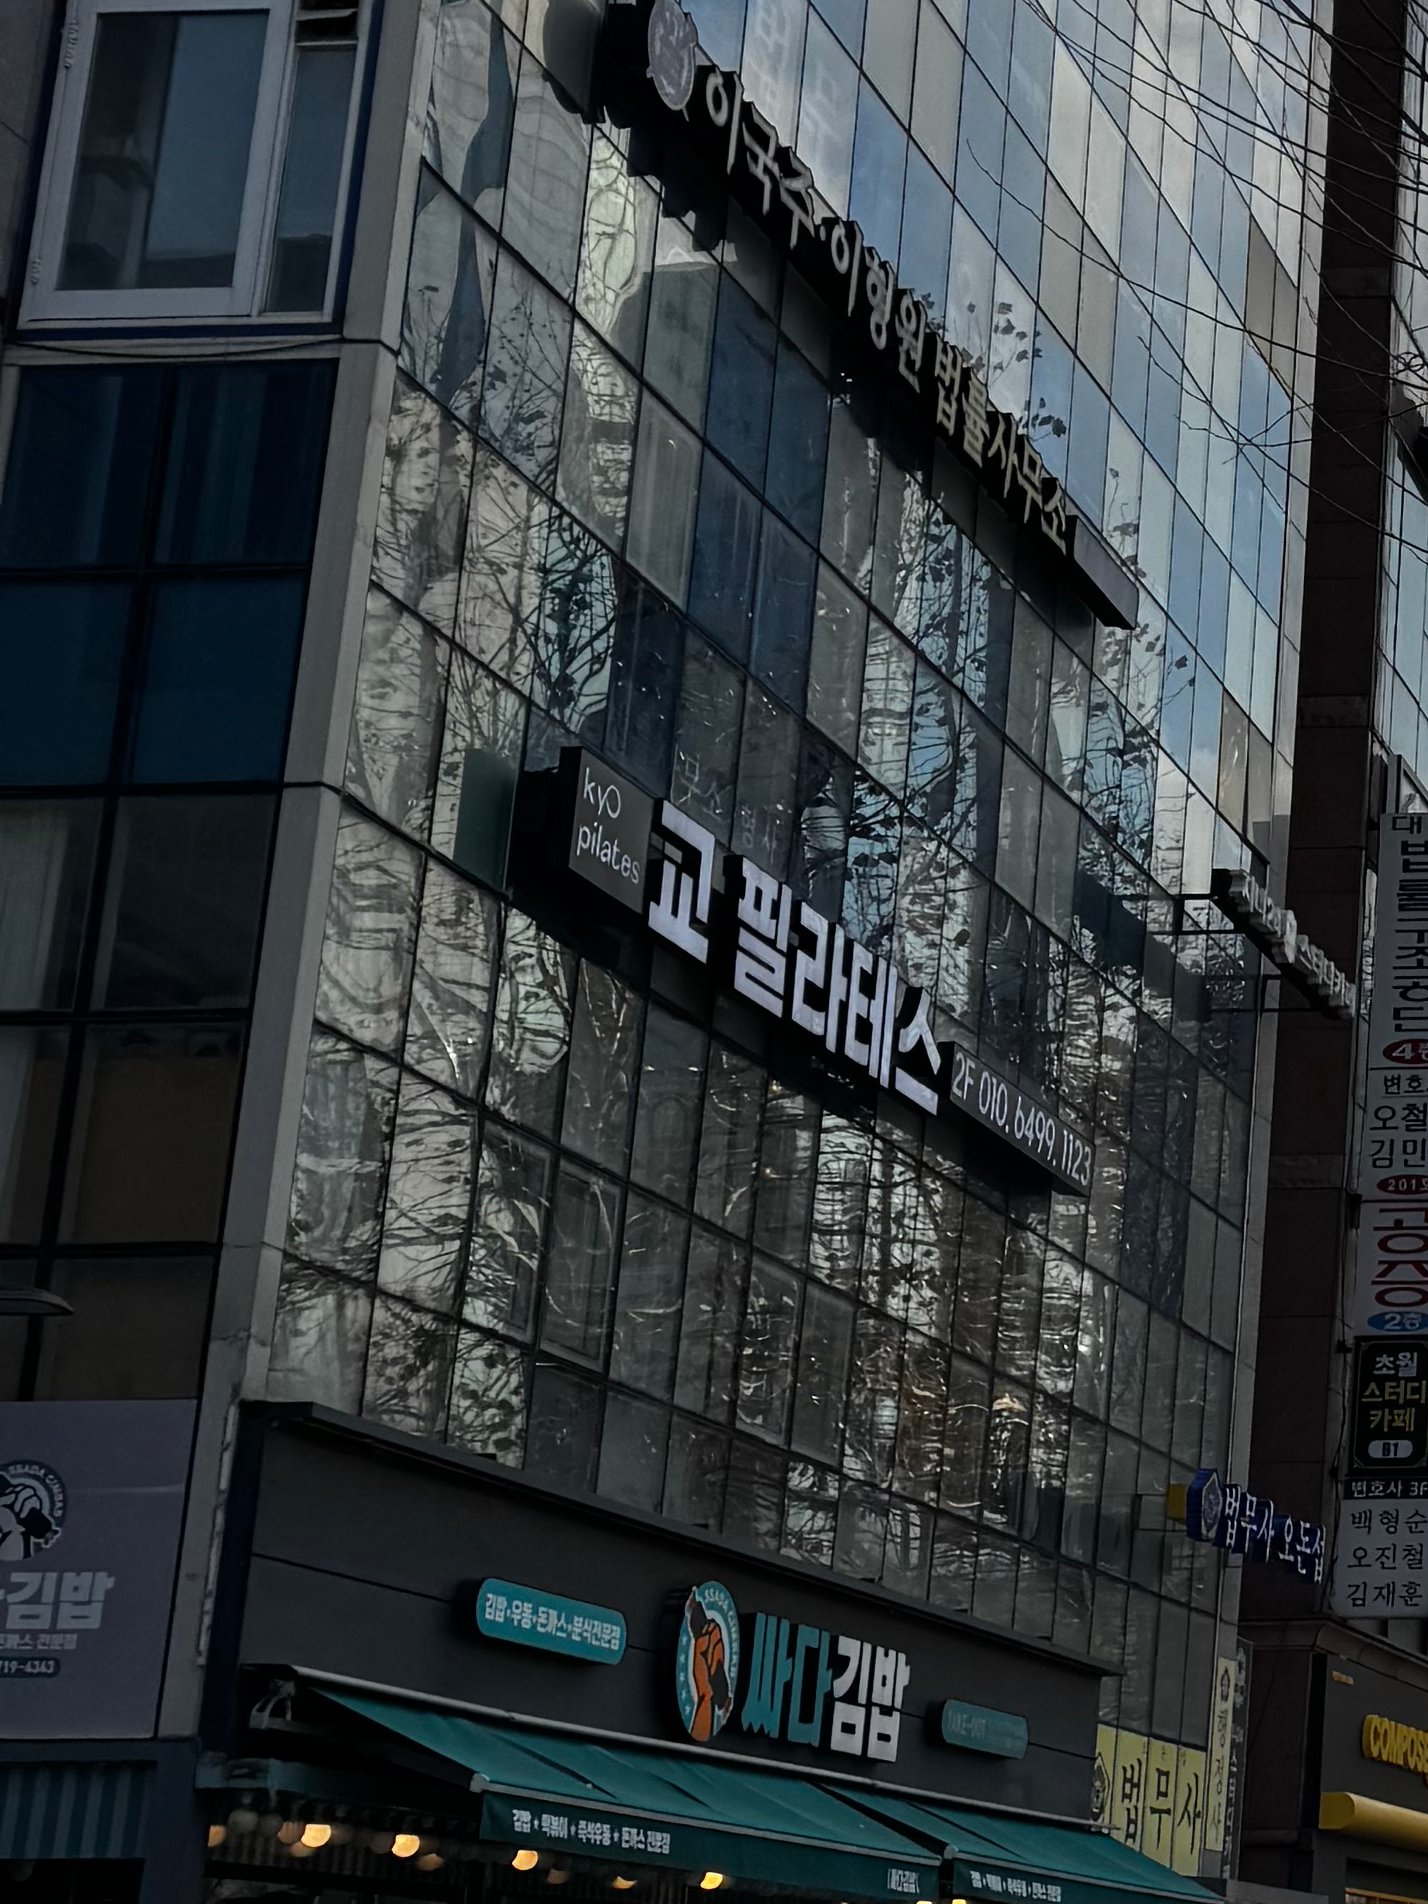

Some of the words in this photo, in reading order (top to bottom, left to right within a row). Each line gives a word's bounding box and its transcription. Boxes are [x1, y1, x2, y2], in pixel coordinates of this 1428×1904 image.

[577, 823, 641, 885] pilates
[648, 800, 717, 964] 교
[734, 854, 942, 1116] 필라테스
[1384, 1312, 1421, 1331] 2층
[1373, 1352, 1418, 1376] 초월
[1361, 1380, 1427, 1404] 스터디
[1369, 1408, 1415, 1432] 카페
[1351, 1480, 1403, 1498] 변호사
[1409, 1481, 1428, 1496] 3F
[1225, 1486, 1274, 1563] 법무사
[0, 1571, 116, 1630] 김밥
[1121, 1758, 1202, 1856] 법무사
